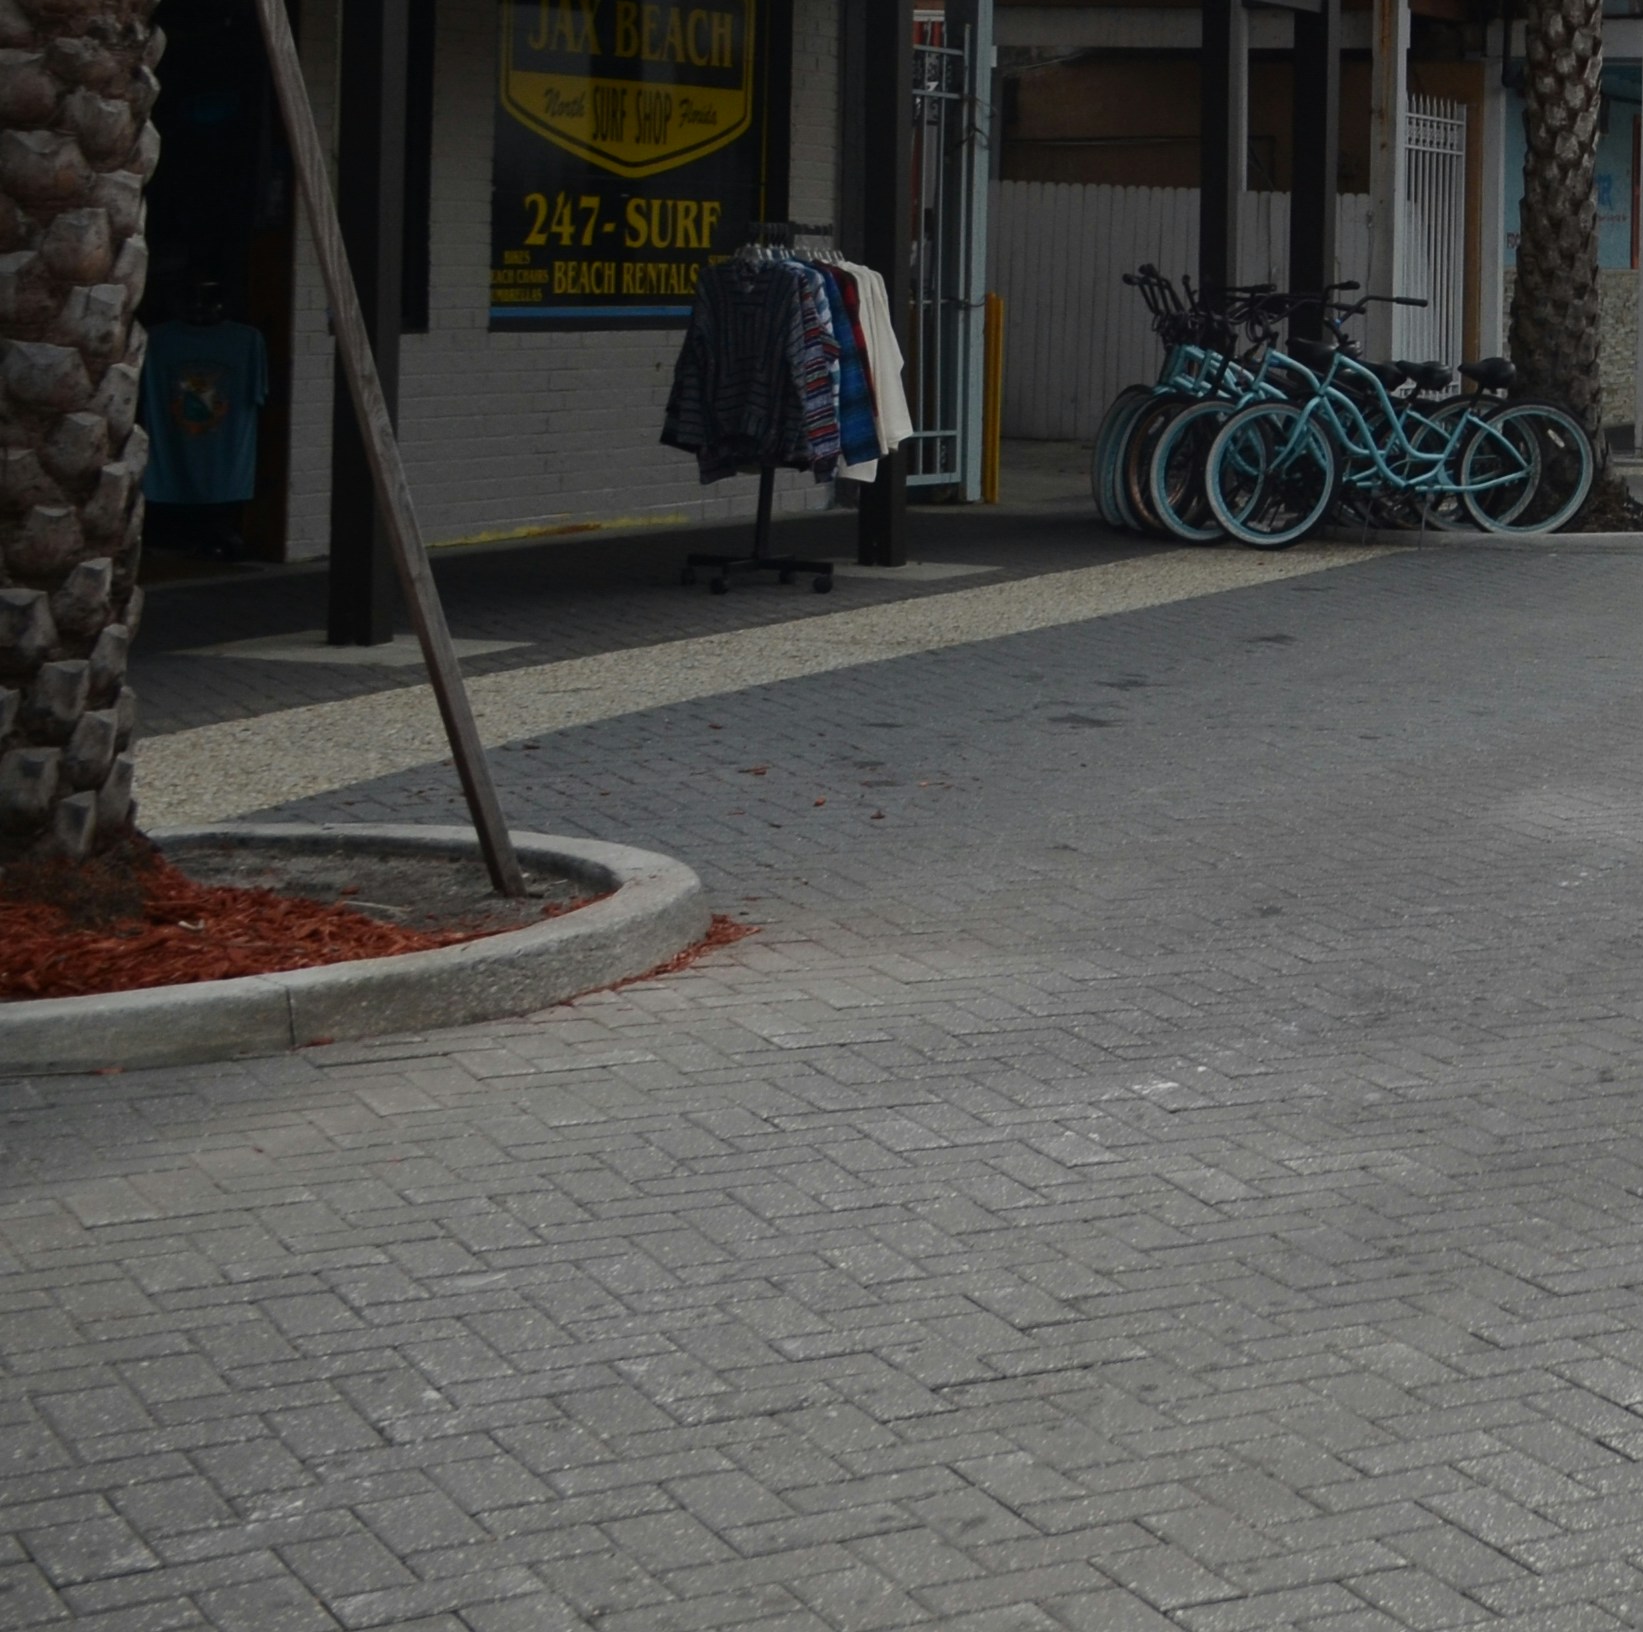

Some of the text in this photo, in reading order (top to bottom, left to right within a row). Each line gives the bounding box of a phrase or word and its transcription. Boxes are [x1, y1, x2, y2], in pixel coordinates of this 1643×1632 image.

[614, 0, 735, 68] BEACH
[544, 84, 718, 145] North SURF SHOP Florida
[551, 259, 700, 296] BEACH RENTALS
